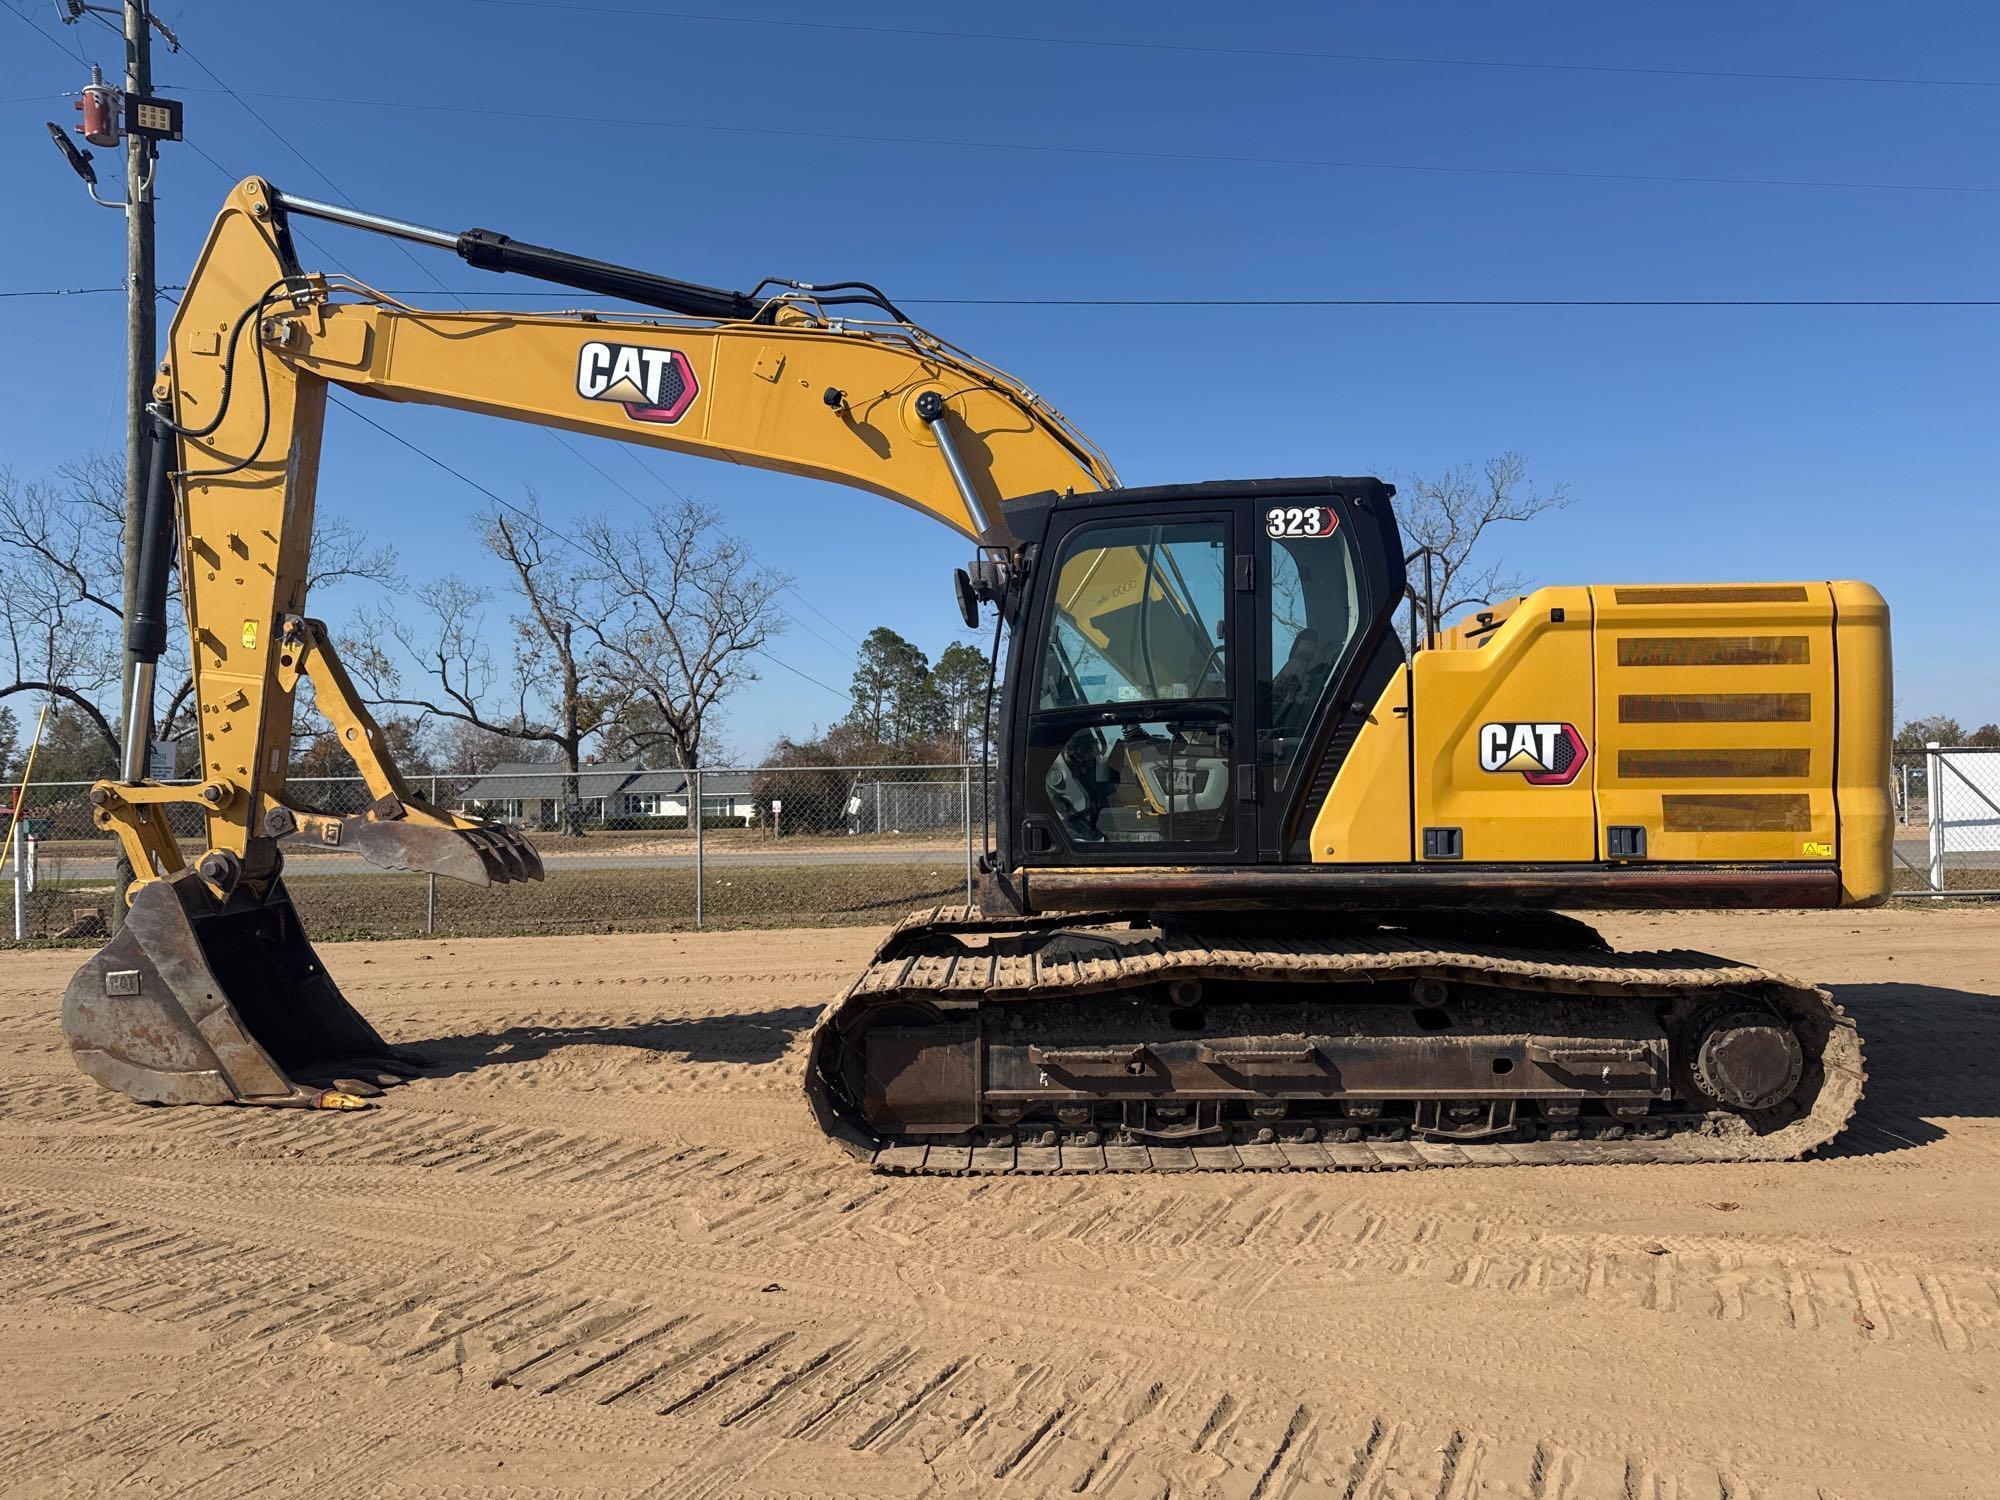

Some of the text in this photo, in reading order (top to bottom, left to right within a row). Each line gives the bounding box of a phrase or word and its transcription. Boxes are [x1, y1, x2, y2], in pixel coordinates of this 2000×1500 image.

[579, 342, 671, 404] CAT
[1269, 508, 1320, 535] 323
[1481, 724, 1561, 770] CAT
